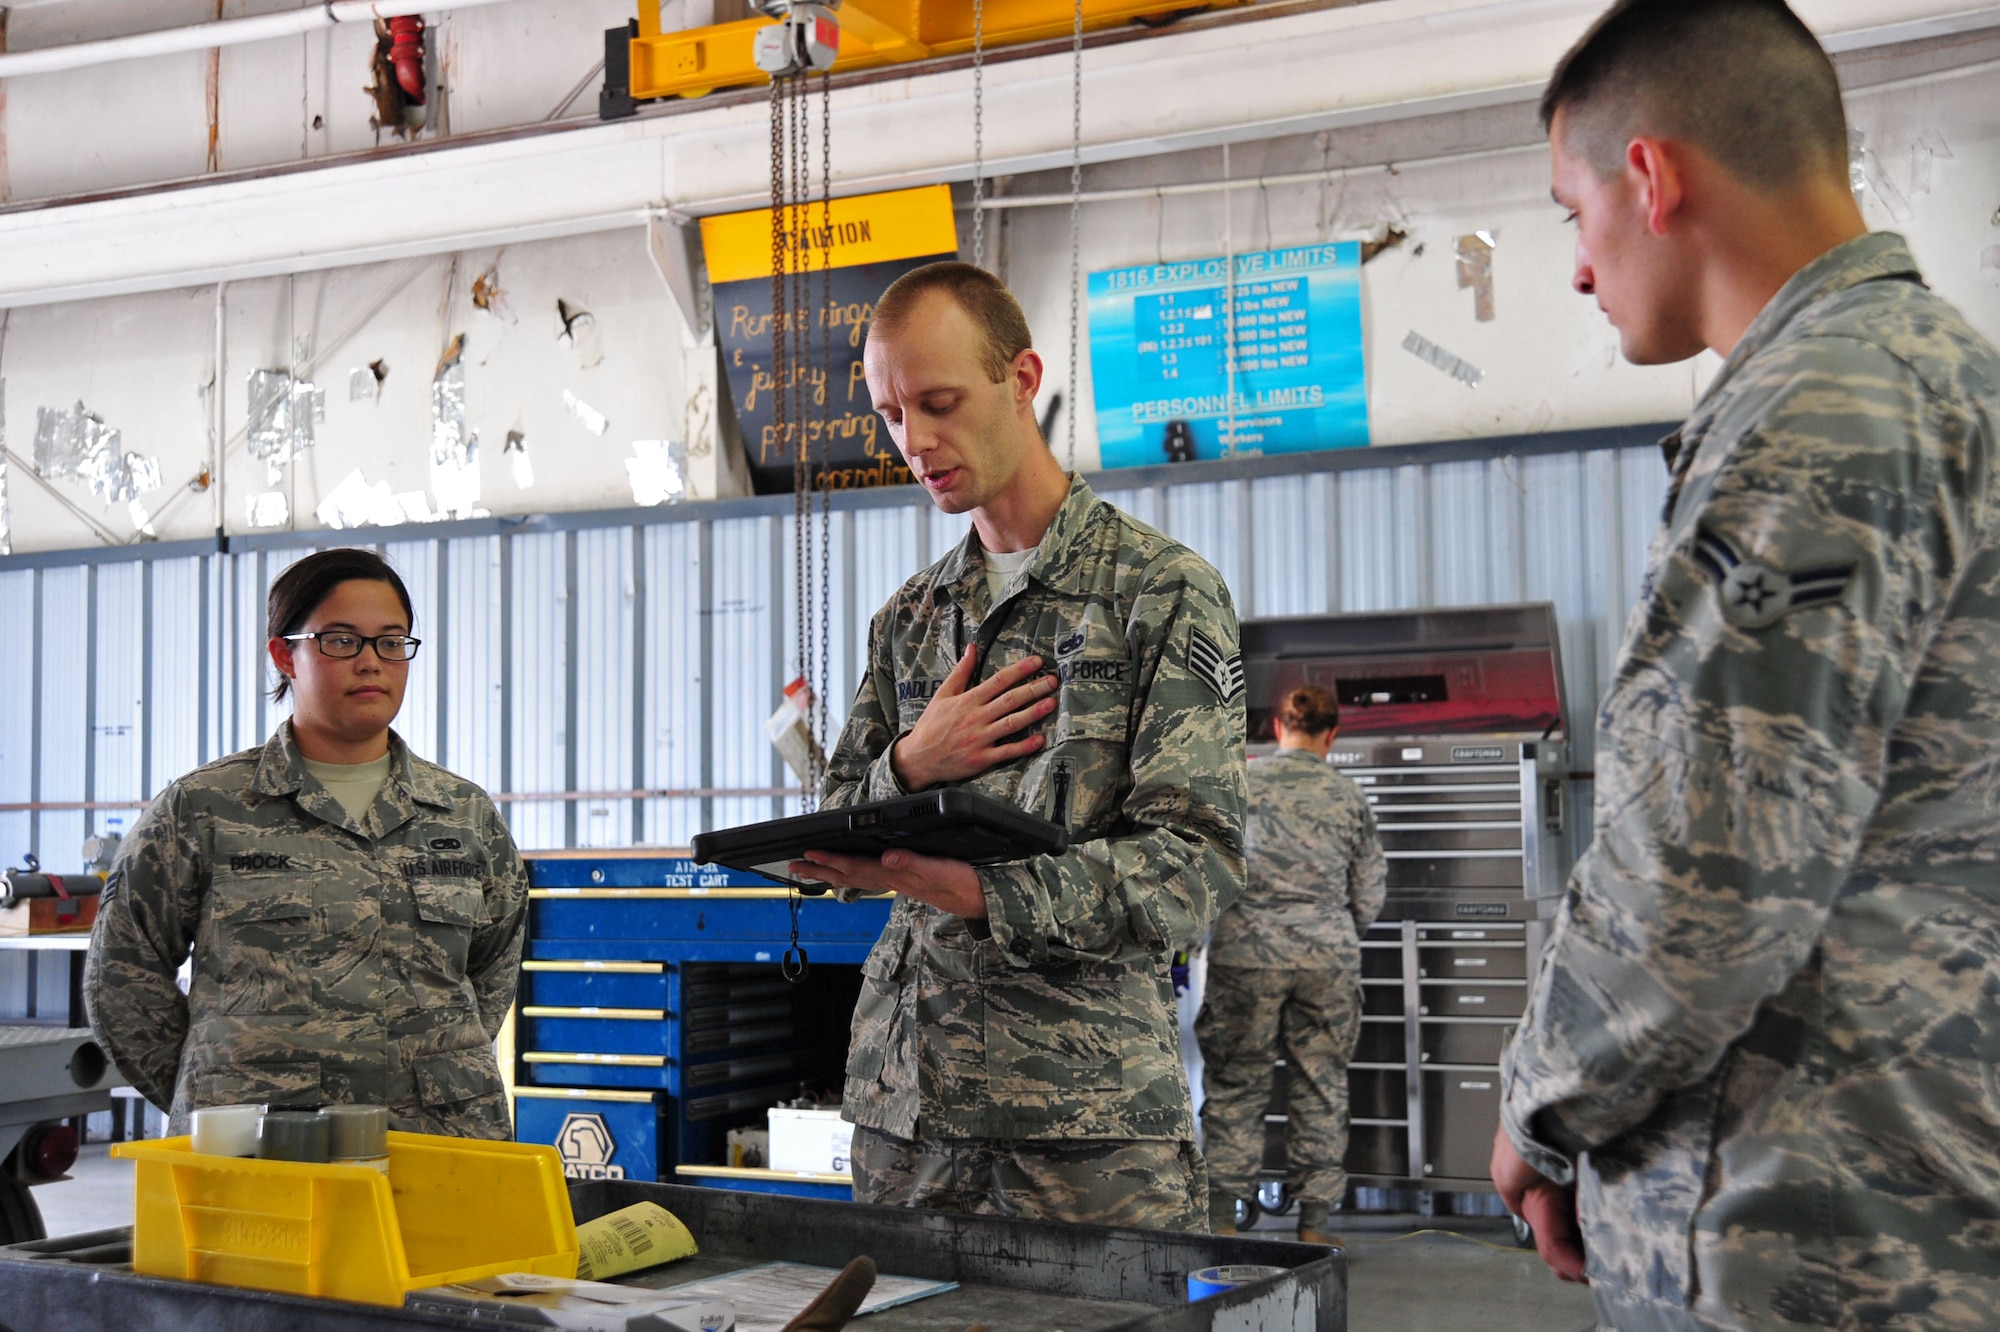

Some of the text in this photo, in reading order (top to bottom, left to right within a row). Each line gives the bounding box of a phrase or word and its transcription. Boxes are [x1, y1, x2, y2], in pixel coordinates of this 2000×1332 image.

[1107, 268, 1149, 291] 1816
[1270, 245, 1337, 270] LIMITS
[1270, 280, 1299, 293] NEW
[1261, 296, 1290, 308] NEW
[1277, 309, 1307, 322] NEW
[1278, 324, 1308, 337] NEW
[1279, 339, 1308, 352] NEW
[1281, 354, 1310, 367] NEW
[1256, 384, 1324, 408] LIMITS
[1070, 660, 1125, 681] FORCE
[231, 854, 291, 871] BROCK
[665, 873, 730, 888] TEST CART
